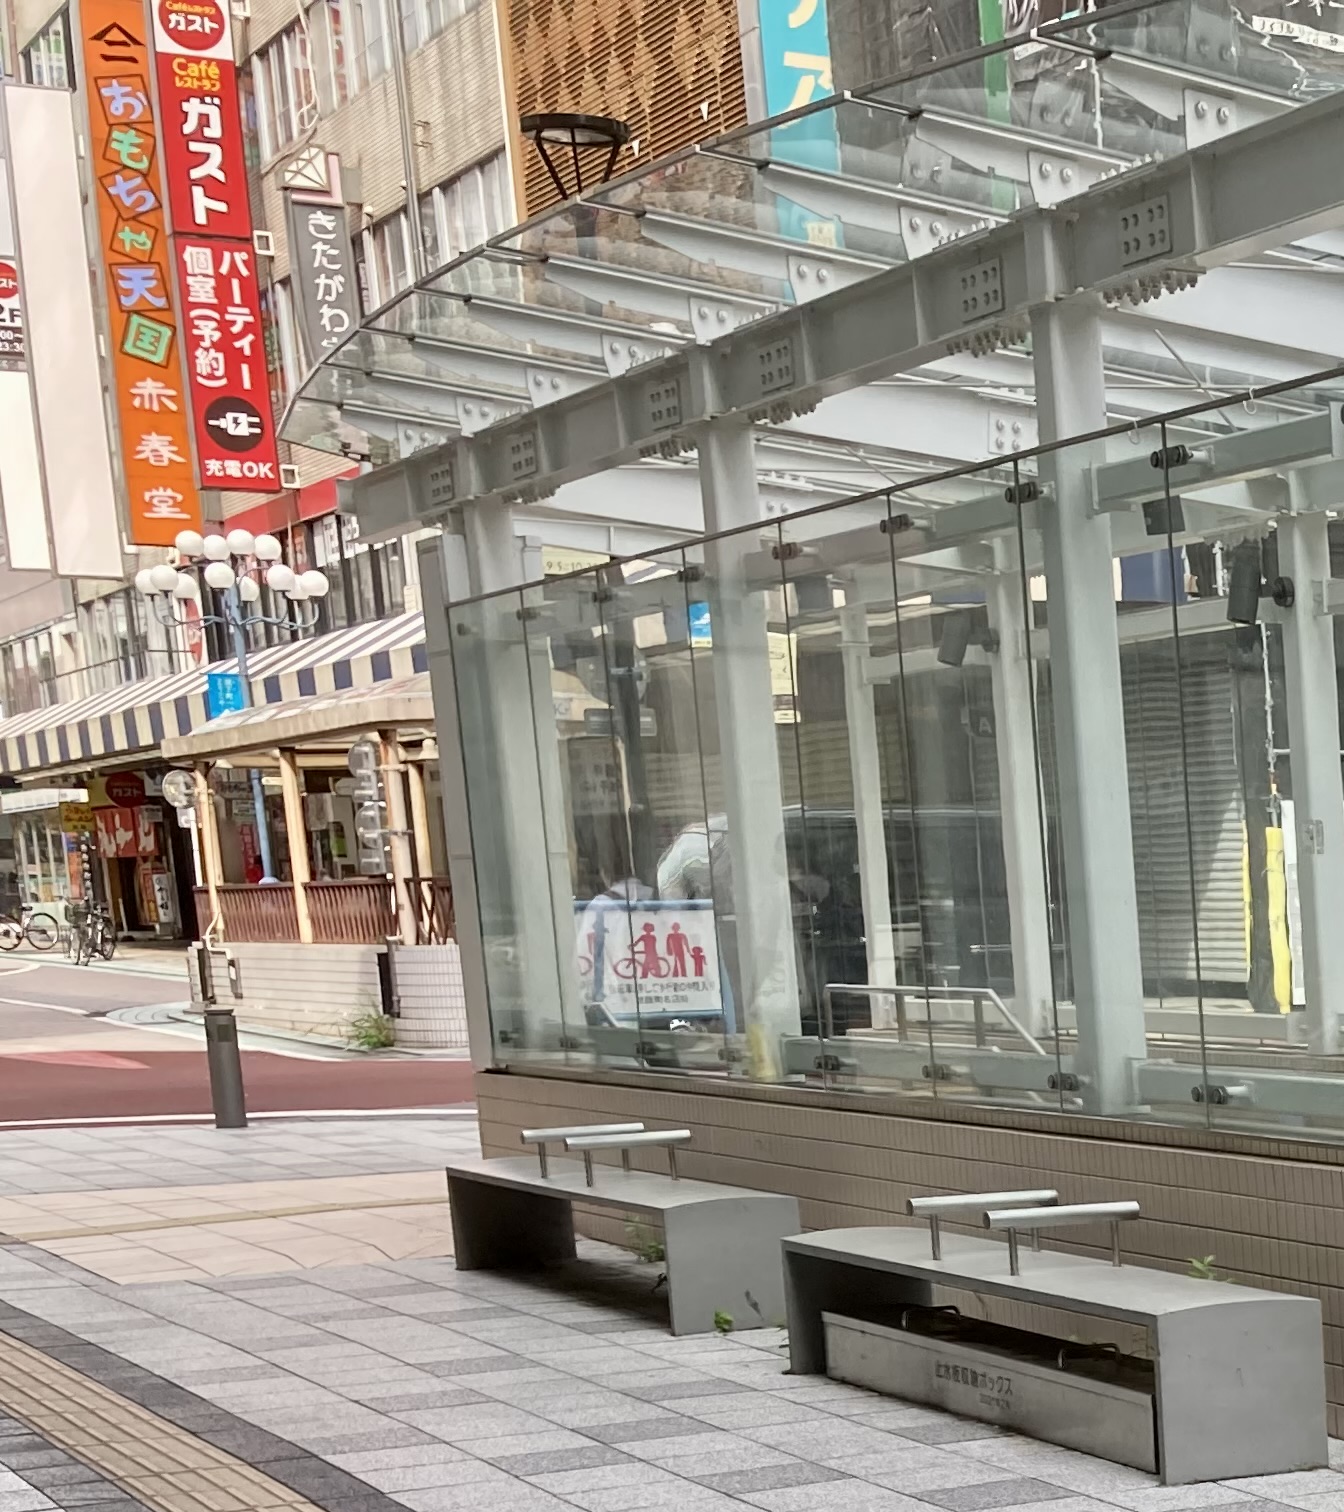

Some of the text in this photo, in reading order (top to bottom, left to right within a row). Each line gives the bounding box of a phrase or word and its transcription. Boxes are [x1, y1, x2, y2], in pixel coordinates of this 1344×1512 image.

[168, 13, 220, 34] ガスト
[172, 57, 220, 80] Café
[174, 76, 221, 92] レストラン
[181, 96, 229, 226] ガスト
[100, 79, 173, 366] おもちゃ天国
[218, 250, 255, 391] パーティー
[129, 377, 191, 519] 赤春堂
[204, 458, 276, 480] 充電OK
